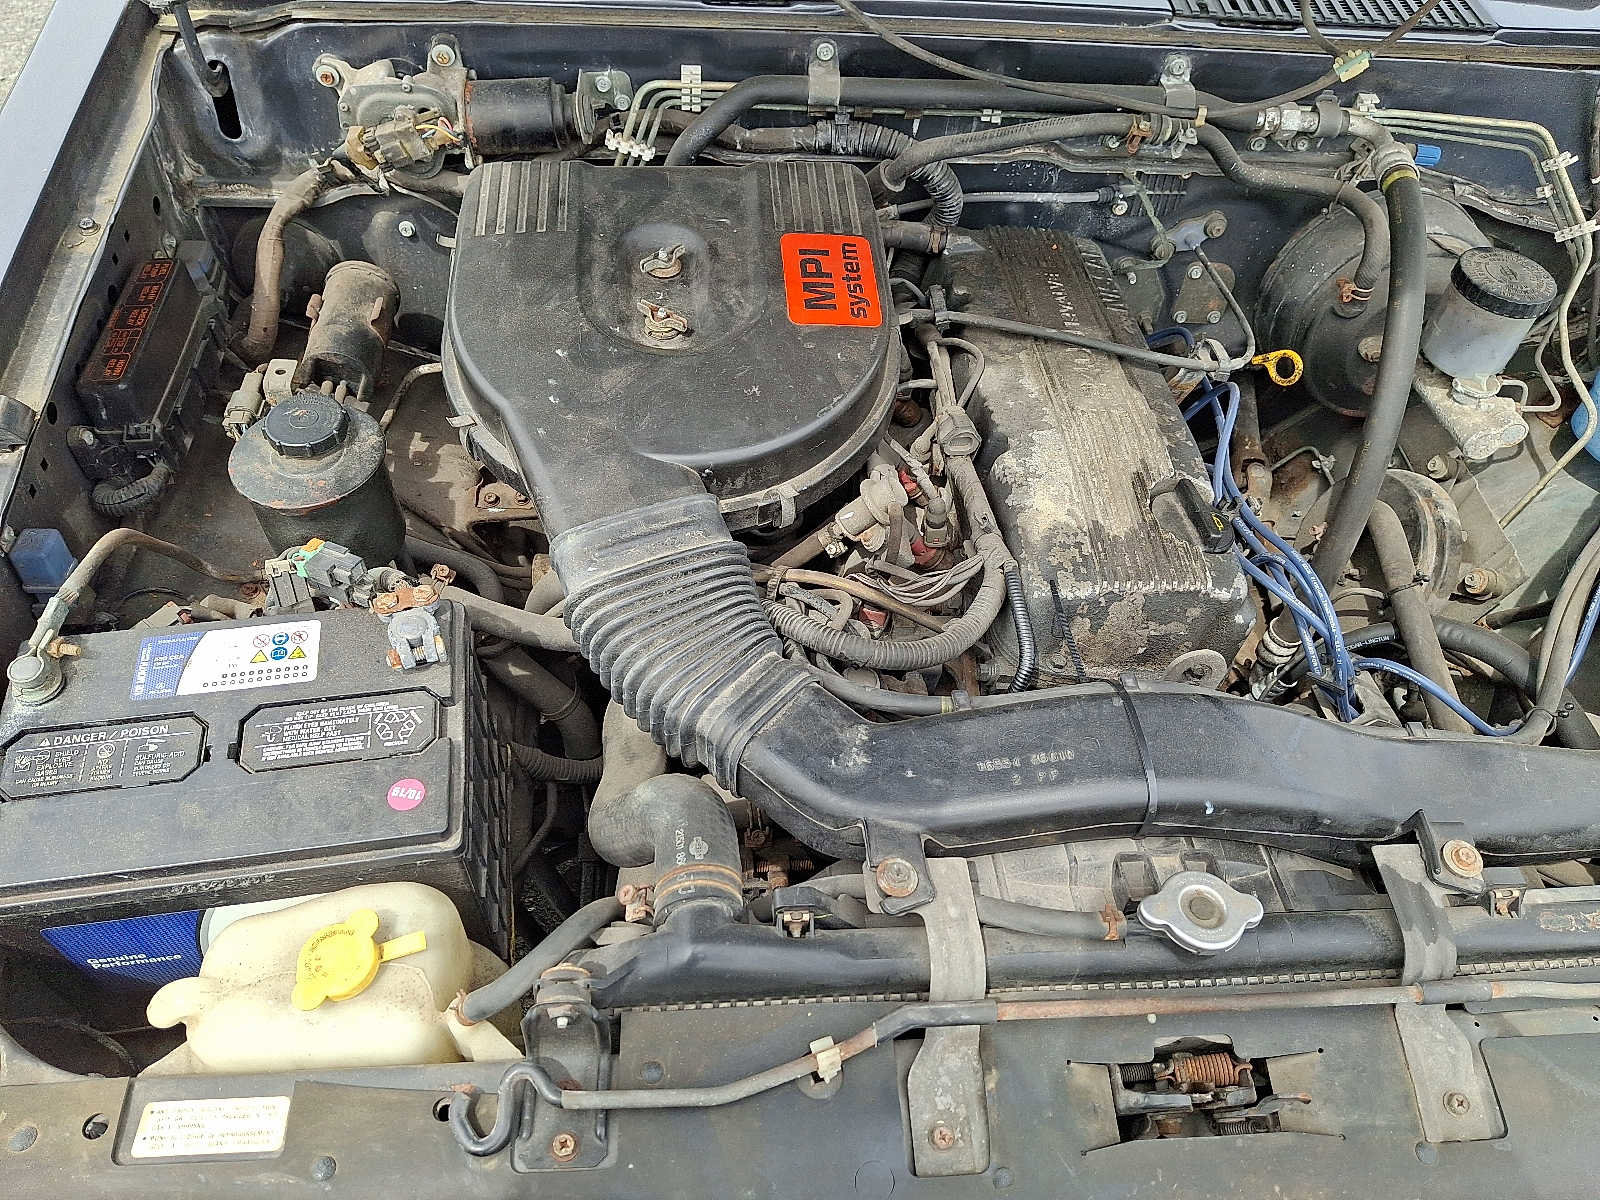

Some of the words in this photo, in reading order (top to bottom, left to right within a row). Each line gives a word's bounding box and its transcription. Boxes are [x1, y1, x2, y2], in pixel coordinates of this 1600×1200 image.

[798, 249, 837, 310] MPI
[842, 243, 870, 318] system
[53, 731, 107, 746] DANGER
[120, 725, 169, 739] POISON
[87, 953, 147, 965] Genuine
[91, 954, 182, 969] Performance
